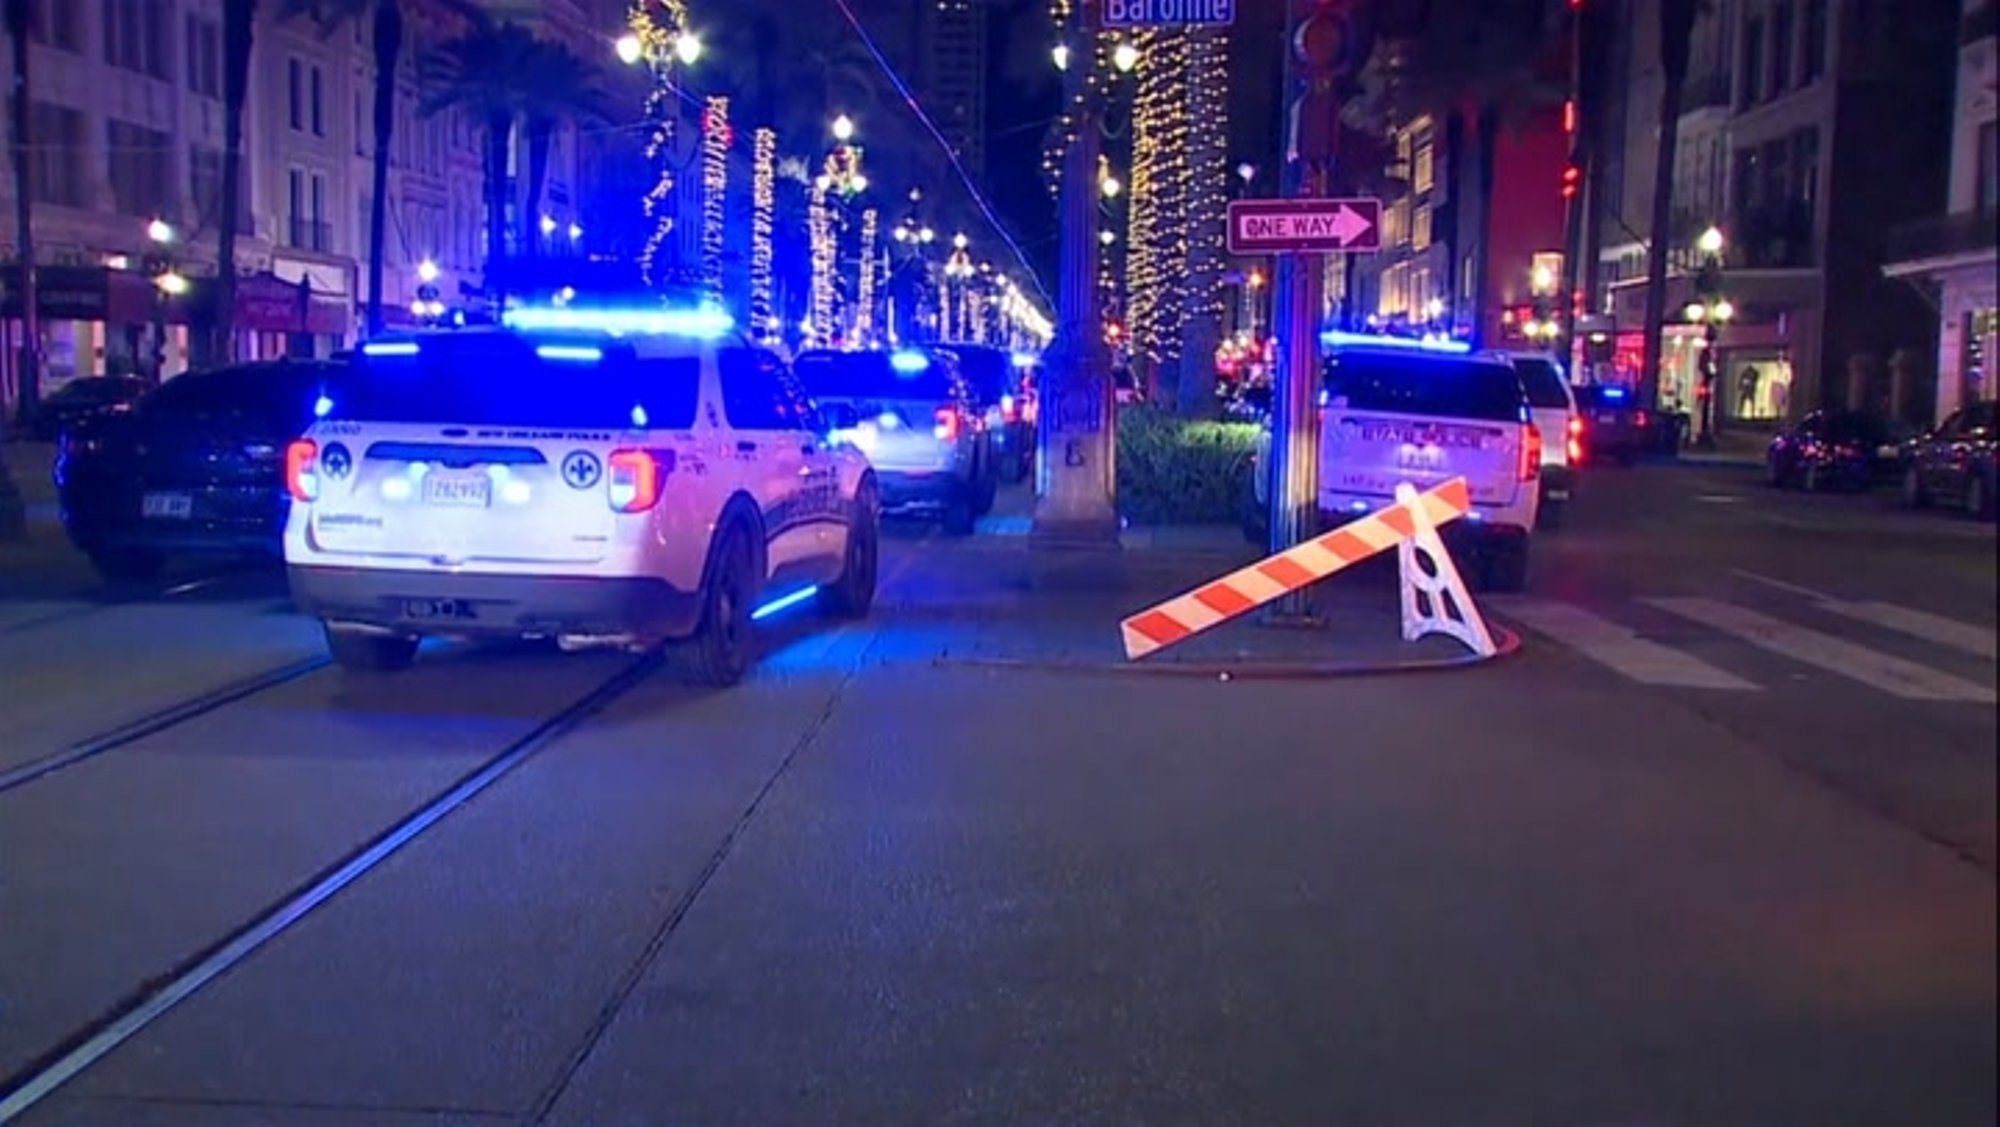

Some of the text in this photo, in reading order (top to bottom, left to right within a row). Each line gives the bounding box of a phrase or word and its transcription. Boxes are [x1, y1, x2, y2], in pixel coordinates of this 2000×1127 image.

[1108, 0, 1229, 20] Baronne
[1246, 217, 1335, 236] ONE WAY
